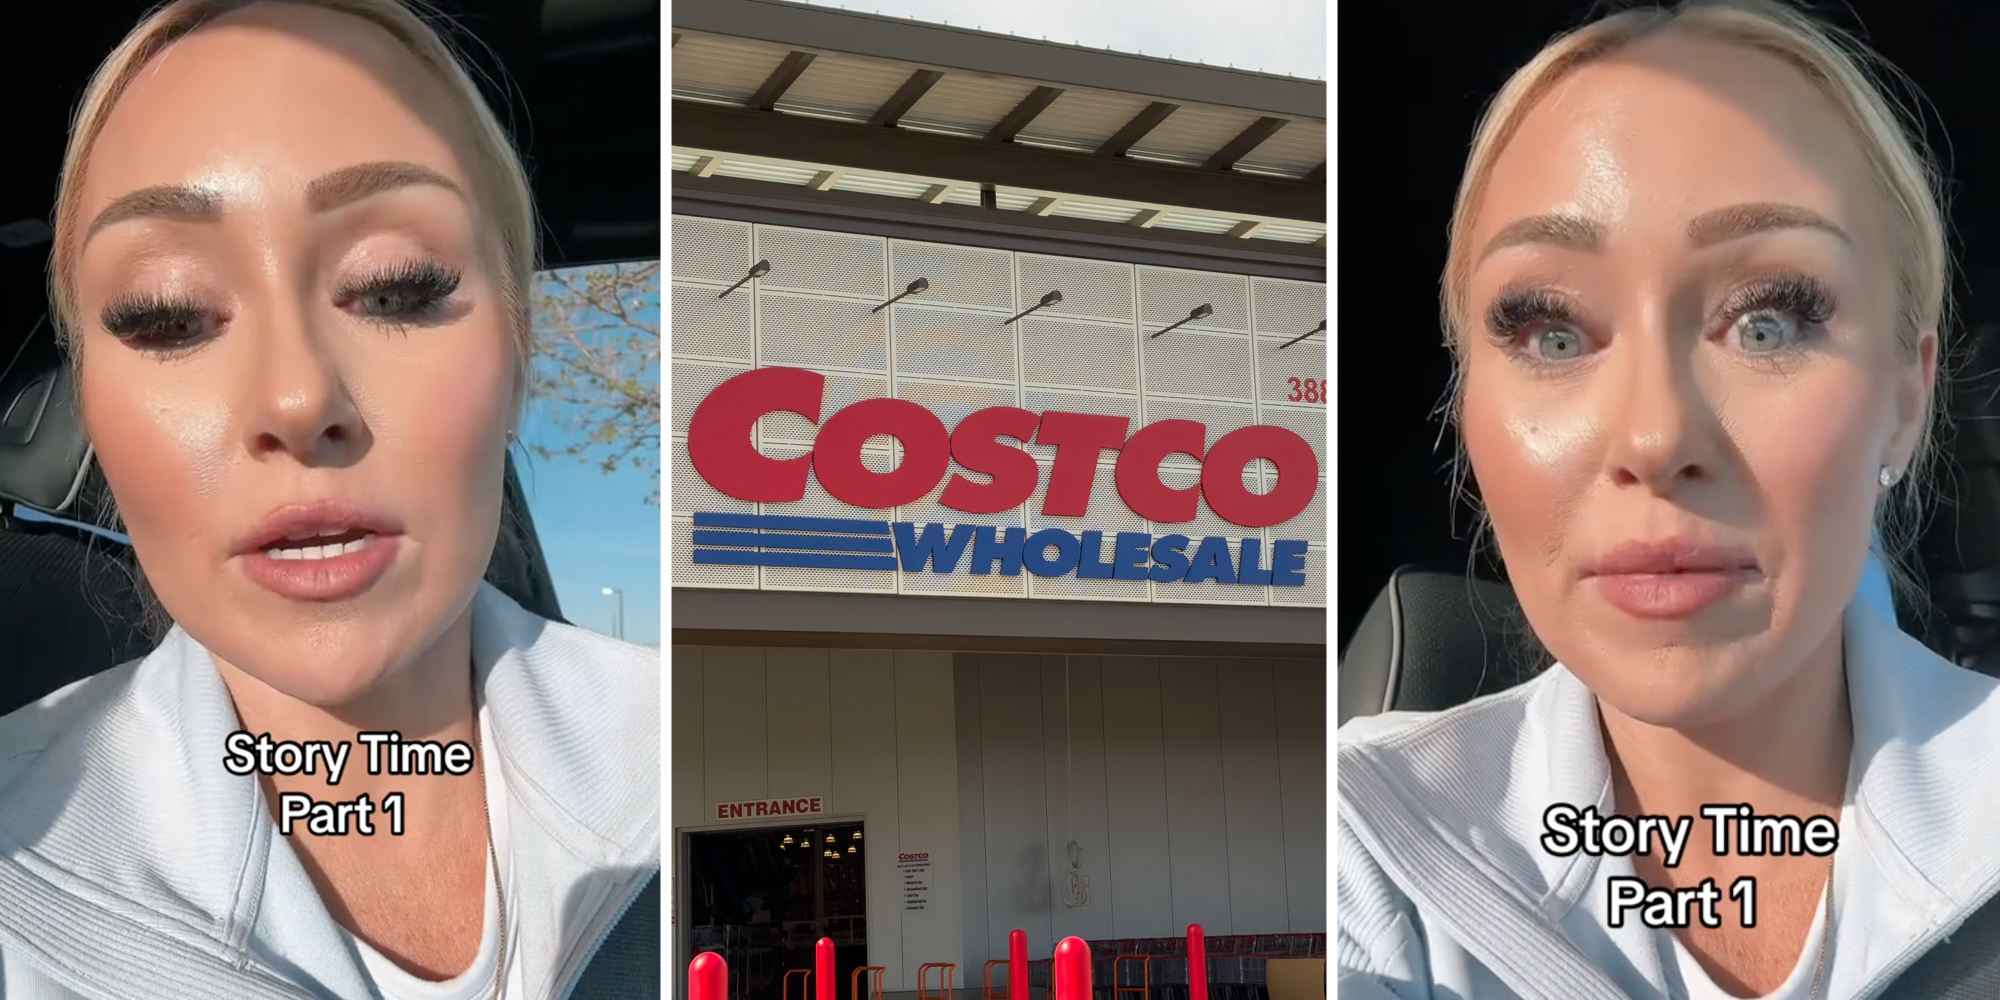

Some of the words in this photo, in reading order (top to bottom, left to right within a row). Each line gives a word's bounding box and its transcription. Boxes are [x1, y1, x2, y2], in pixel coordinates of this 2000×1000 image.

[687, 365, 1319, 528] COSTCO
[892, 521, 1308, 587] WHOLESALE
[718, 798, 821, 818] ENTRANCE
[898, 852, 929, 860] COSTCO
